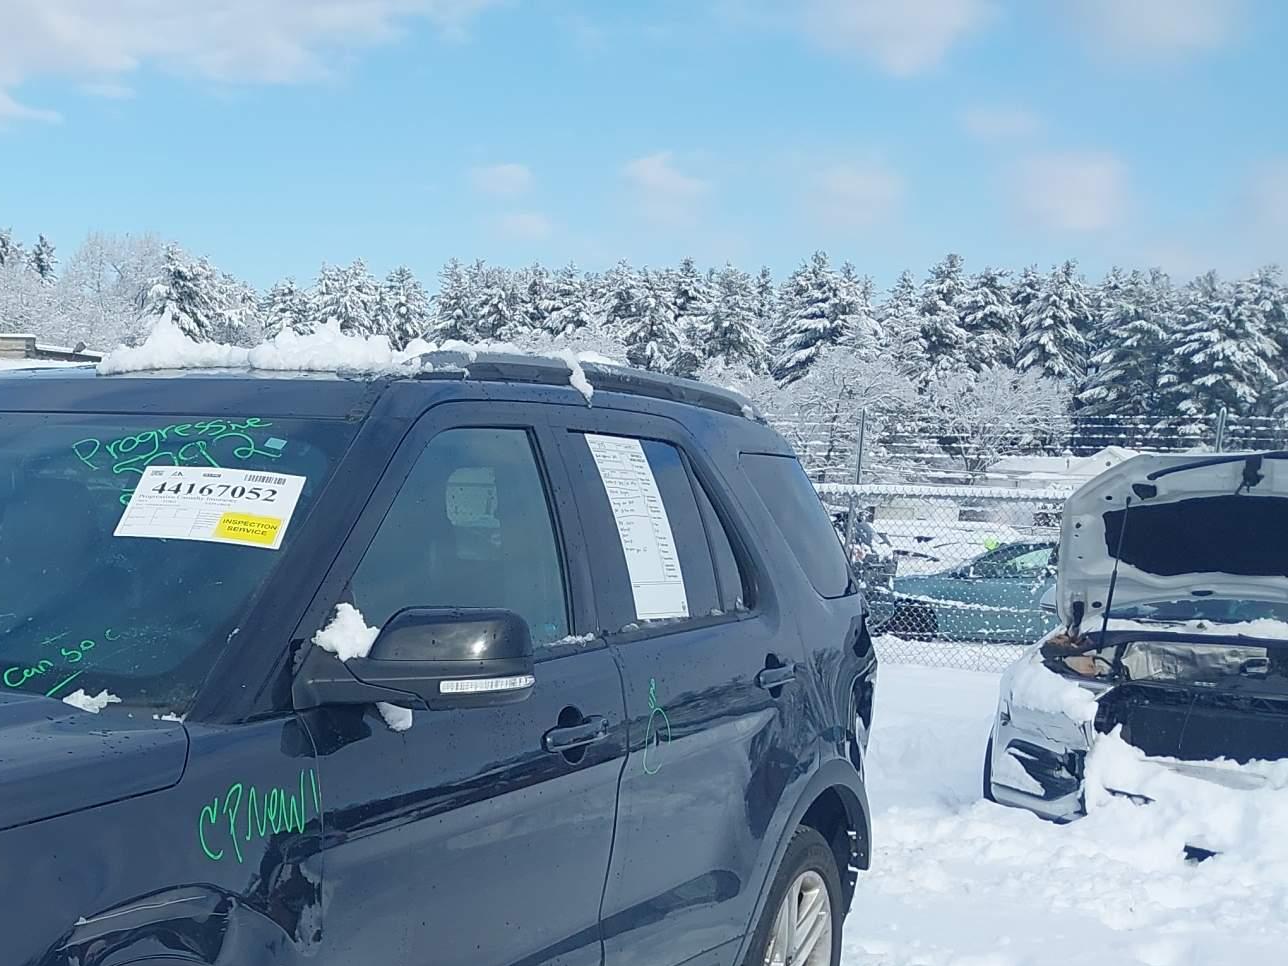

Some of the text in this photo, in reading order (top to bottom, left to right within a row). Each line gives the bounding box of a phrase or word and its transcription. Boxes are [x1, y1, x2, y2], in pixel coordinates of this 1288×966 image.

[151, 481, 278, 502] 44167052
[222, 518, 278, 531] INSPECTION
[226, 525, 268, 536] SERVICE
